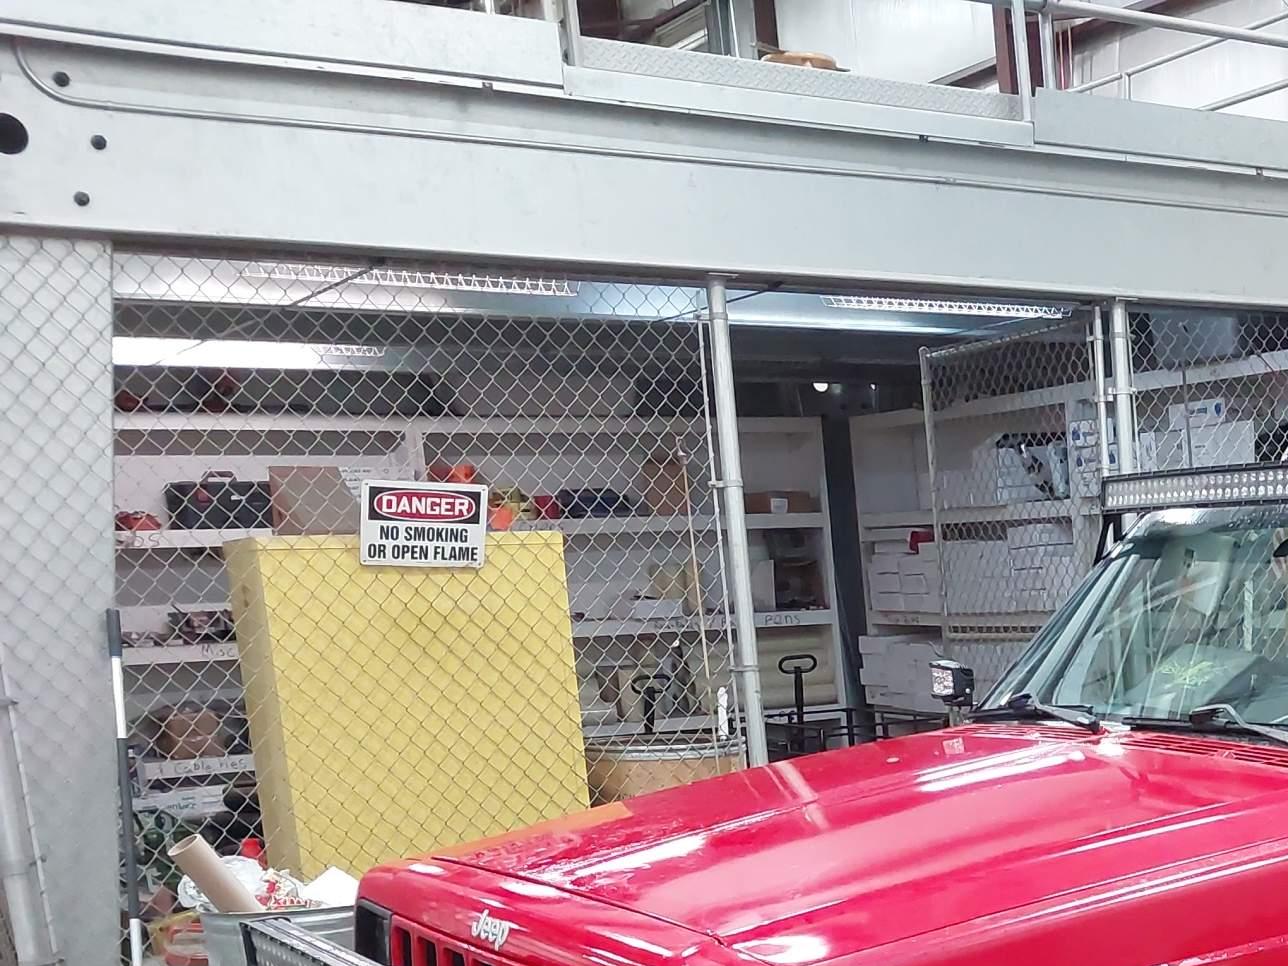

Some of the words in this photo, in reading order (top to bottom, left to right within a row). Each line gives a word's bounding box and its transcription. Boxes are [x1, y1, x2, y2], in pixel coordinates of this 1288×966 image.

[381, 494, 469, 516] DANGER
[379, 525, 400, 541] NO
[404, 527, 468, 543] SMOKING
[367, 543, 386, 559] OR
[391, 544, 429, 561] OPEN
[433, 545, 478, 562] FLAME
[471, 908, 510, 952] Jeep
